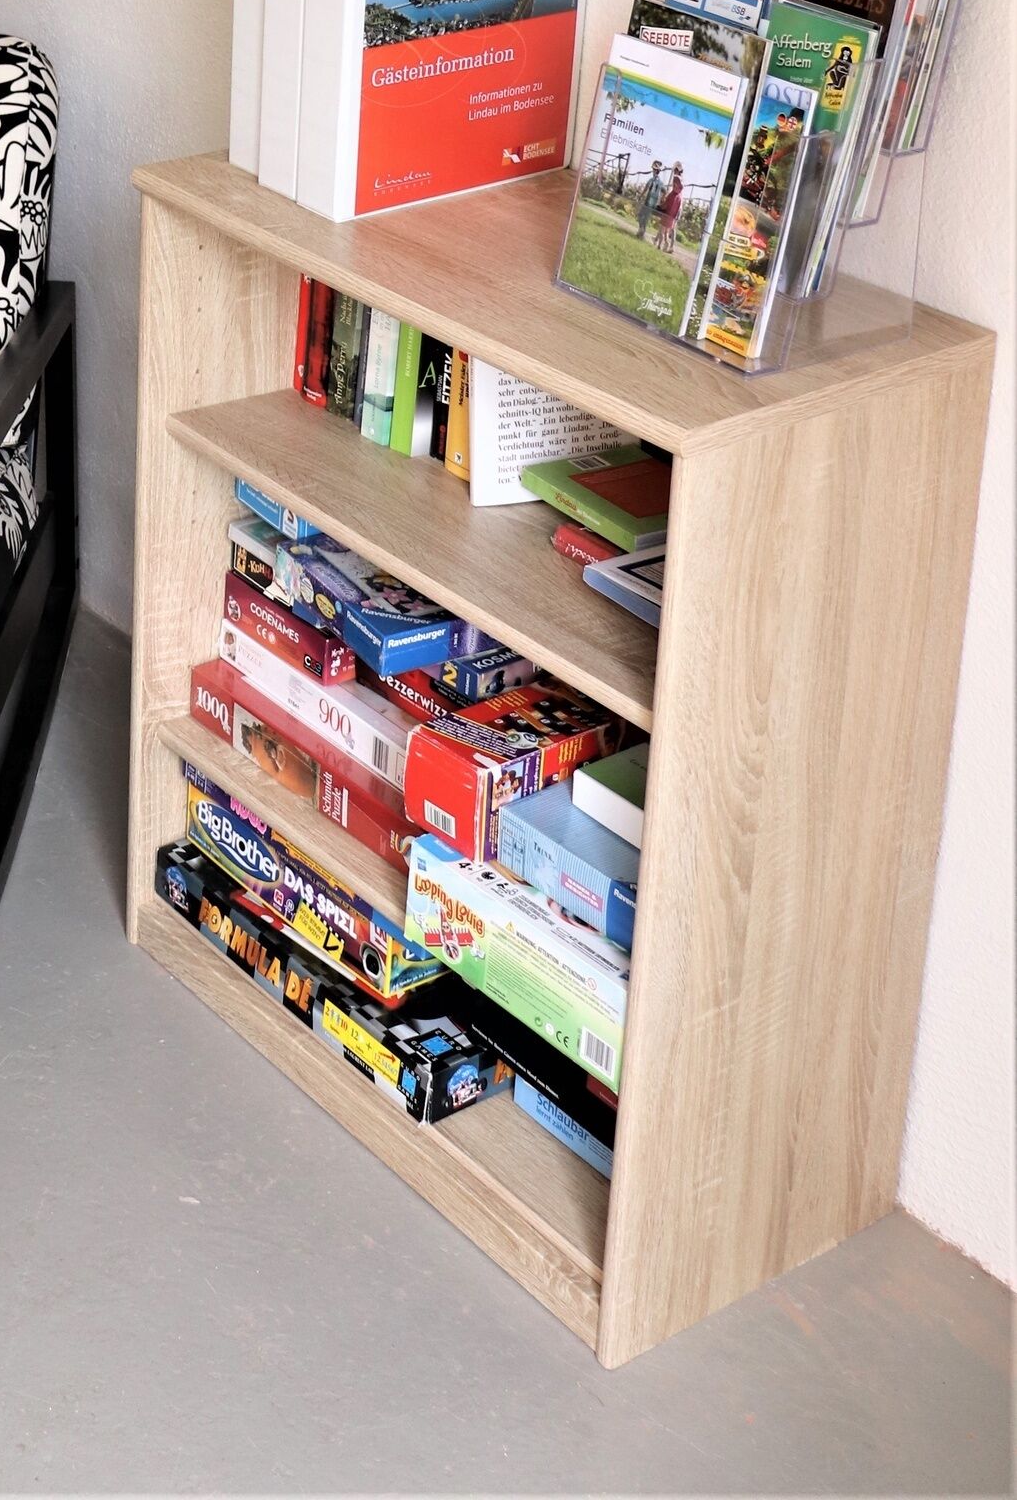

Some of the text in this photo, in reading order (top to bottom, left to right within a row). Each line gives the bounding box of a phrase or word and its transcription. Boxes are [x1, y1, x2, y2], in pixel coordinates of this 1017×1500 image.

[731, 4, 746, 16] BSB
[642, 30, 690, 48] SEEBOTE
[771, 33, 832, 58] Affenberg
[371, 47, 515, 88] Gästeinformation
[776, 51, 812, 68] Salem
[469, 81, 543, 105] Informationen zu
[468, 94, 555, 121] Lindau im Bodensee
[603, 113, 645, 136] Familien
[522, 146, 555, 160] BODENSEE
[523, 142, 539, 153] ECHT
[374, 171, 431, 189] Lindau
[335, 341, 347, 404] Anne Perry
[419, 360, 437, 388] A
[441, 352, 453, 405] FITZEK
[498, 378, 512, 386] das
[498, 388, 515, 397] sehr
[498, 400, 512, 408] den
[498, 407, 541, 419] schnitts-IQ
[543, 405, 555, 414] hat
[498, 421, 511, 430] der
[498, 432, 521, 442] punkt
[525, 430, 537, 438] für
[542, 428, 559, 437] ganz
[498, 430, 622, 451] Verdichtung wäre in der Groß-
[498, 453, 517, 462] stadt
[586, 441, 622, 452] Inselhalle
[498, 464, 520, 473] bietet
[250, 602, 300, 644] CODENAMES
[361, 608, 431, 625] Ravensburger
[346, 610, 382, 647] Ravensburger
[388, 627, 447, 649] Ravensburger
[443, 663, 459, 688] 2
[196, 686, 229, 726] 1000
[319, 698, 352, 739] 900
[322, 771, 333, 816] Schmidt
[332, 787, 342, 822] Puzzle
[222, 816, 279, 881] Brother
[414, 873, 454, 920] Looping
[455, 900, 485, 938] Louie
[199, 897, 313, 1012] FORMULA DÉ
[536, 1105, 551, 1122] lernt
